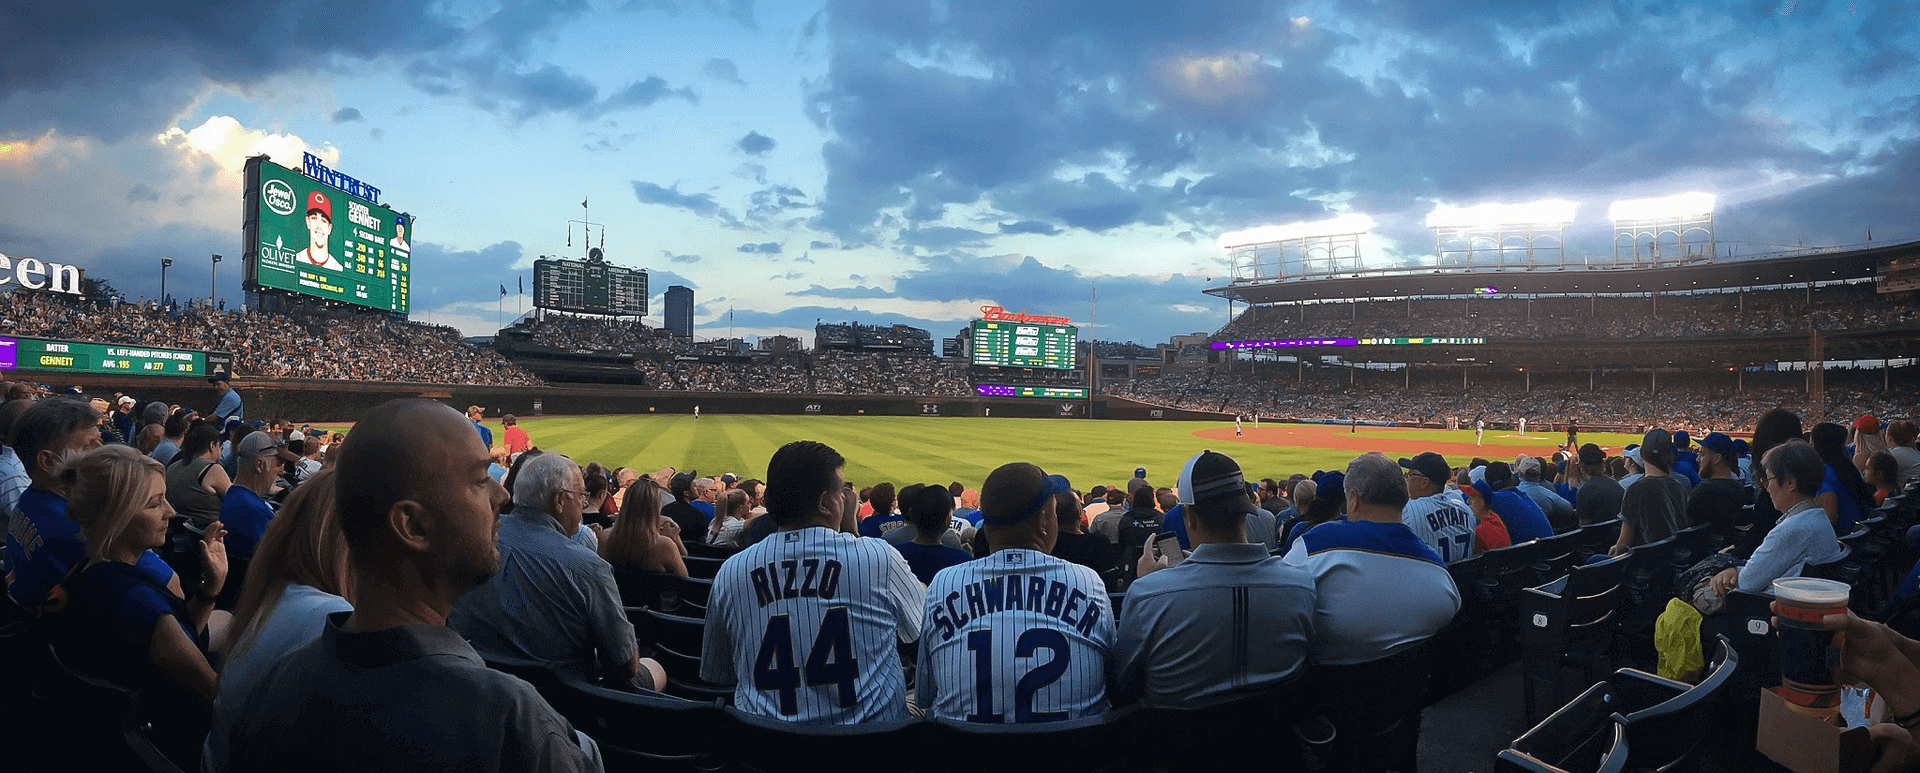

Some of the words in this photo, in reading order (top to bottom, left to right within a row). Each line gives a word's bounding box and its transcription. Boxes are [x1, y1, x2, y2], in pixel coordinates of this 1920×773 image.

[304, 151, 381, 205] WINTRUST
[267, 184, 291, 200] Jewel
[348, 210, 381, 231] GENNETT
[261, 247, 296, 265] OLIVET
[46, 343, 69, 353] BATTER
[107, 347, 116, 356] VS.
[117, 348, 150, 358] LEFT-HANDED
[151, 351, 172, 360] PITCHERS
[173, 353, 193, 361] (CAREER)
[40, 355, 74, 367] GENNETT
[102, 360, 115, 368] AVG
[116, 360, 130, 369] .195
[144, 362, 152, 370] AB
[1426, 507, 1469, 532] BRYANT
[1438, 533, 1471, 563] 17
[750, 559, 842, 608] RIZZO
[932, 574, 1101, 642] SCHWARBER
[1755, 622, 1761, 631] 9
[754, 606, 860, 716] 44
[966, 627, 1071, 723] 12
